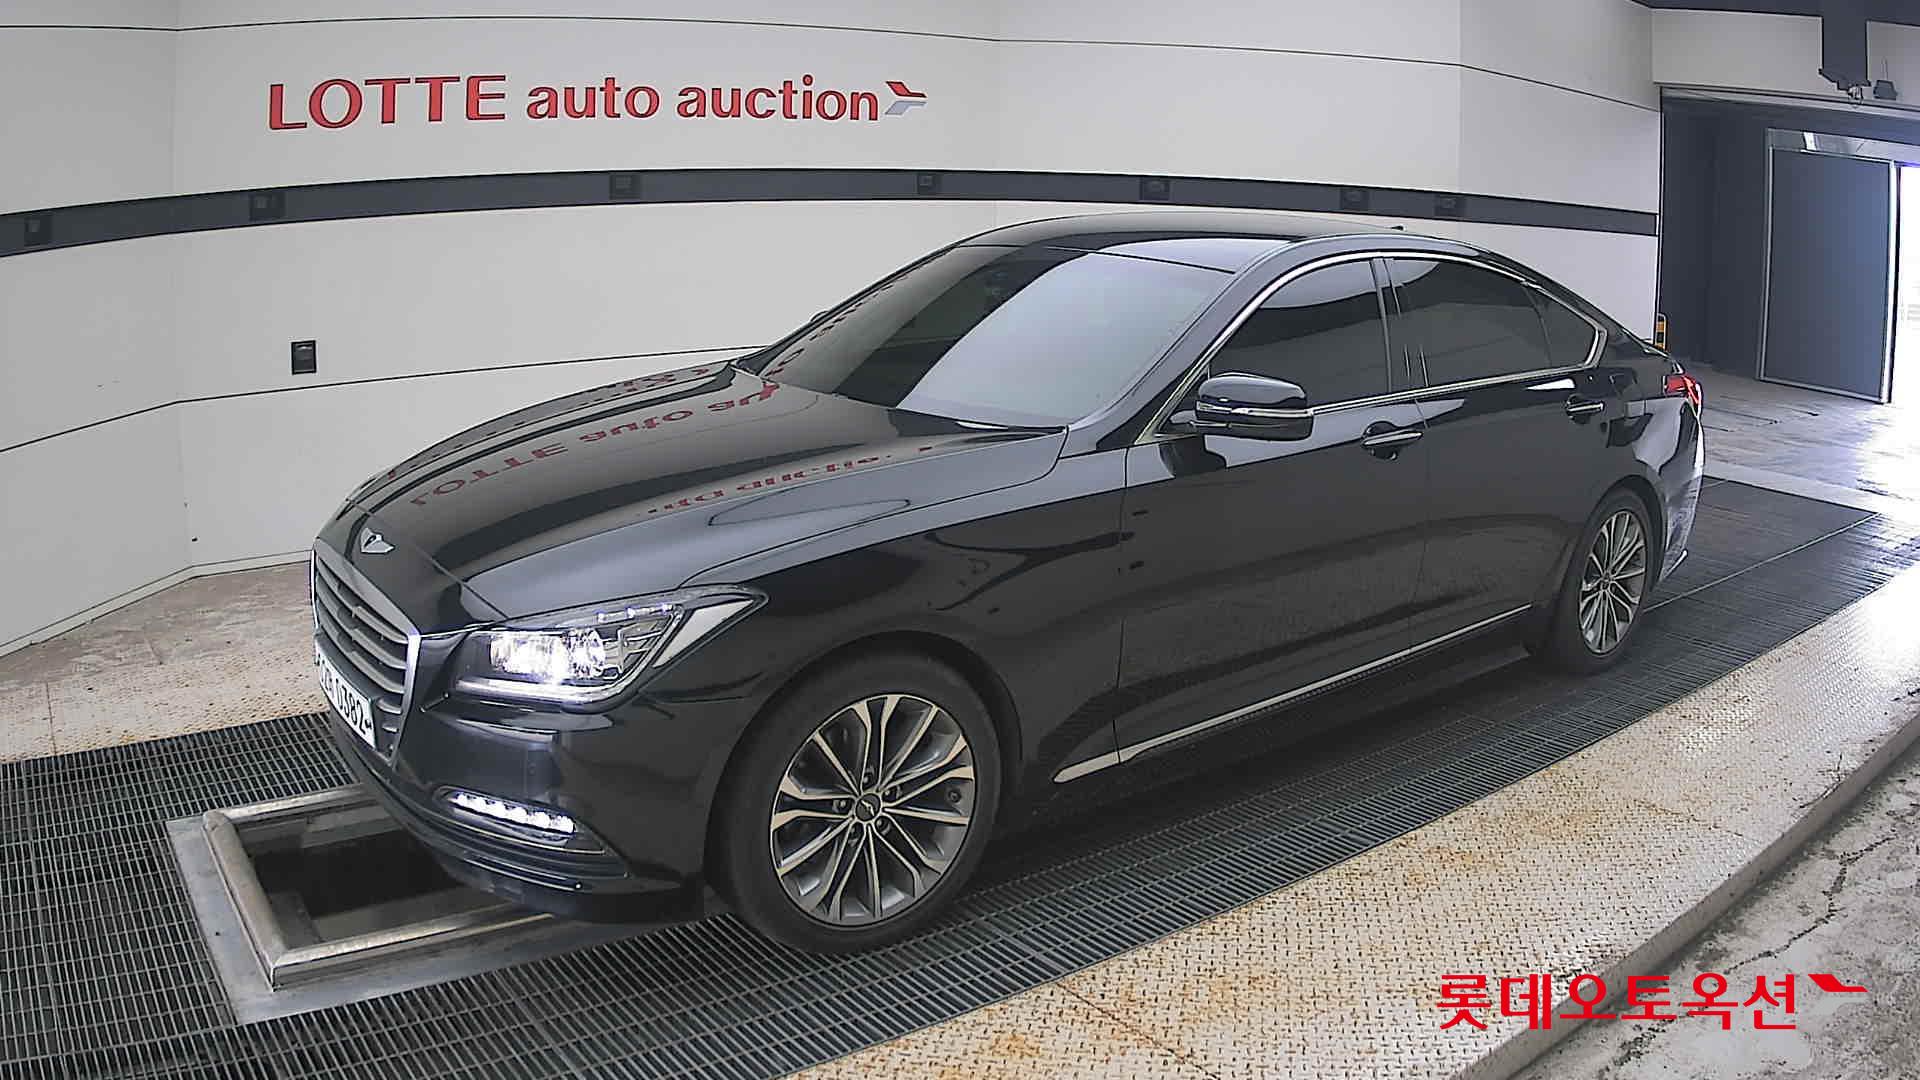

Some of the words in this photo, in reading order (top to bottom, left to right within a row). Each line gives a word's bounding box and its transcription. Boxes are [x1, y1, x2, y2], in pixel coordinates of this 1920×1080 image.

[269, 74, 507, 131] LOTTE
[526, 77, 661, 120] auto
[677, 75, 879, 121] auction
